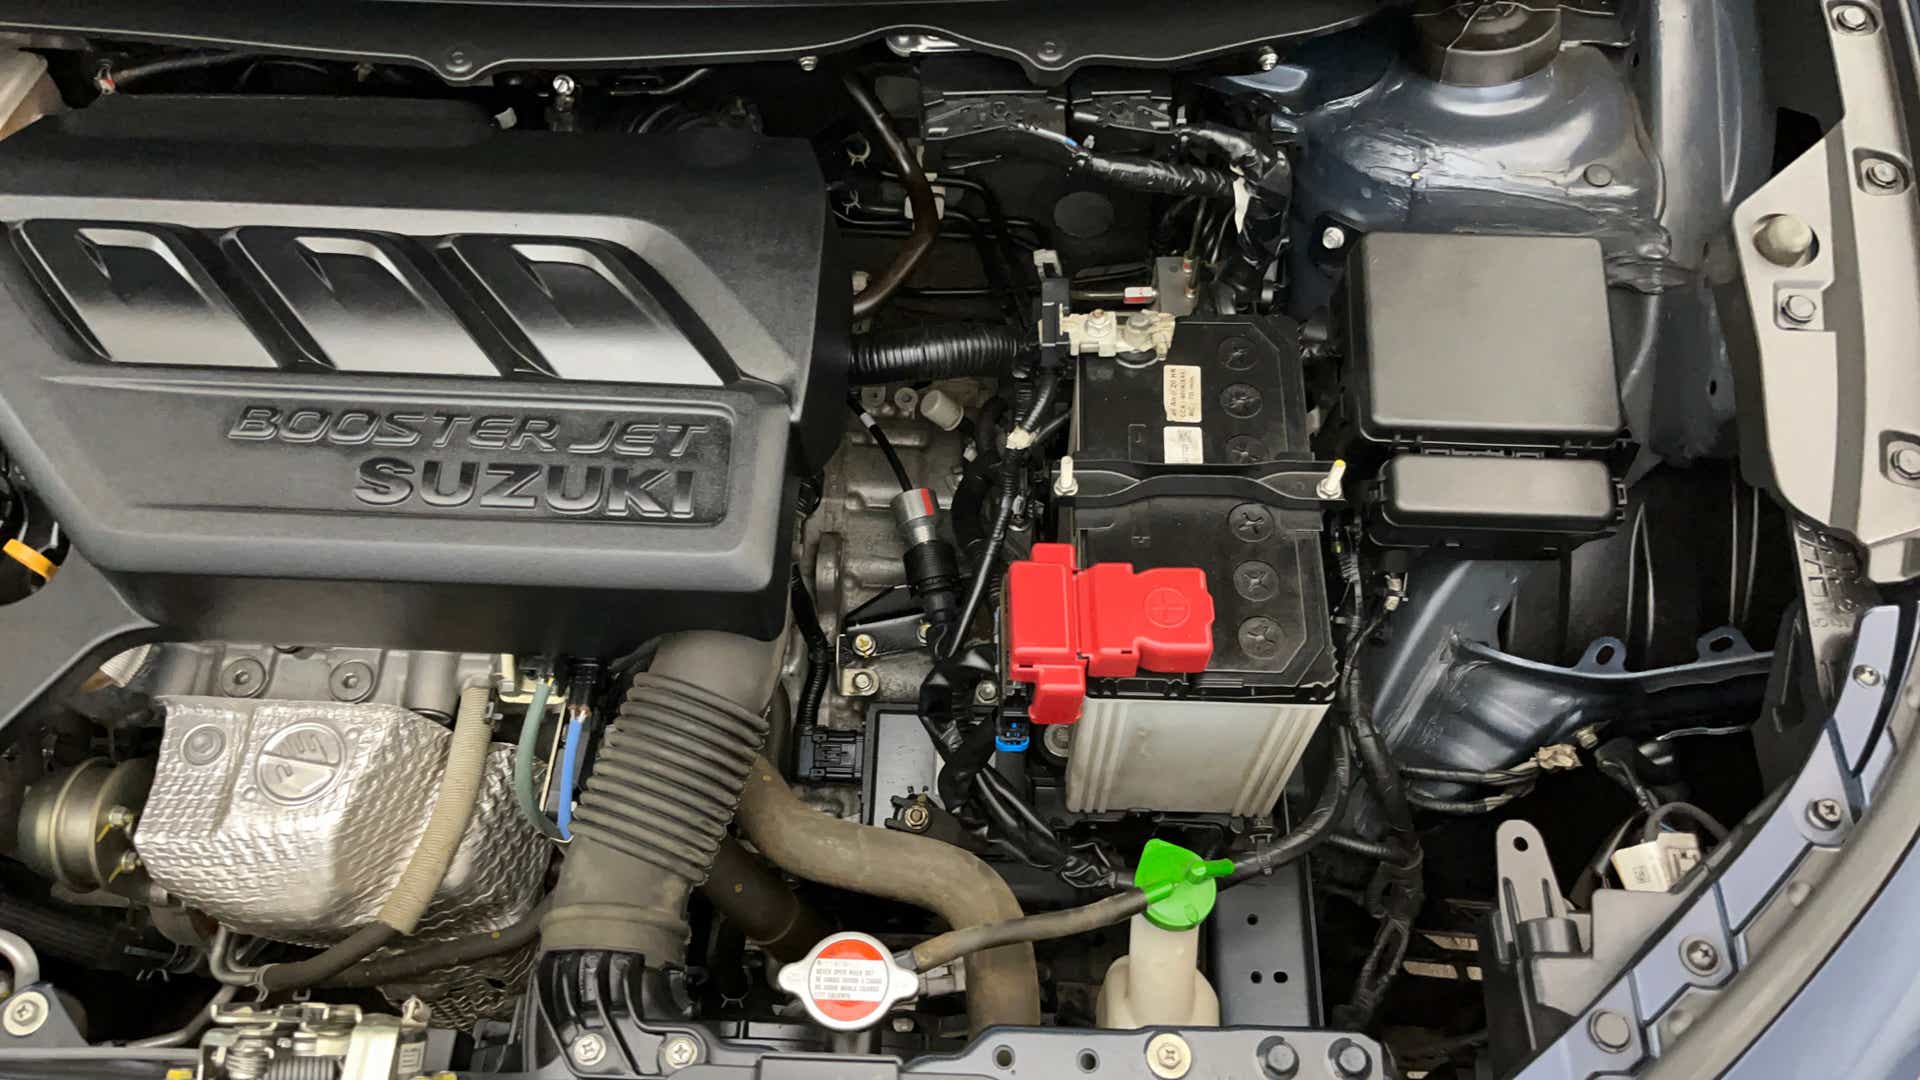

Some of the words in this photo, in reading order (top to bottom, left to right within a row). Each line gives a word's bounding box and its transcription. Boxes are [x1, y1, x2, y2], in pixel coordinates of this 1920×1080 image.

[228, 406, 560, 451] BOOSTER
[568, 421, 710, 457] JET
[353, 457, 695, 518] SUZUKI
